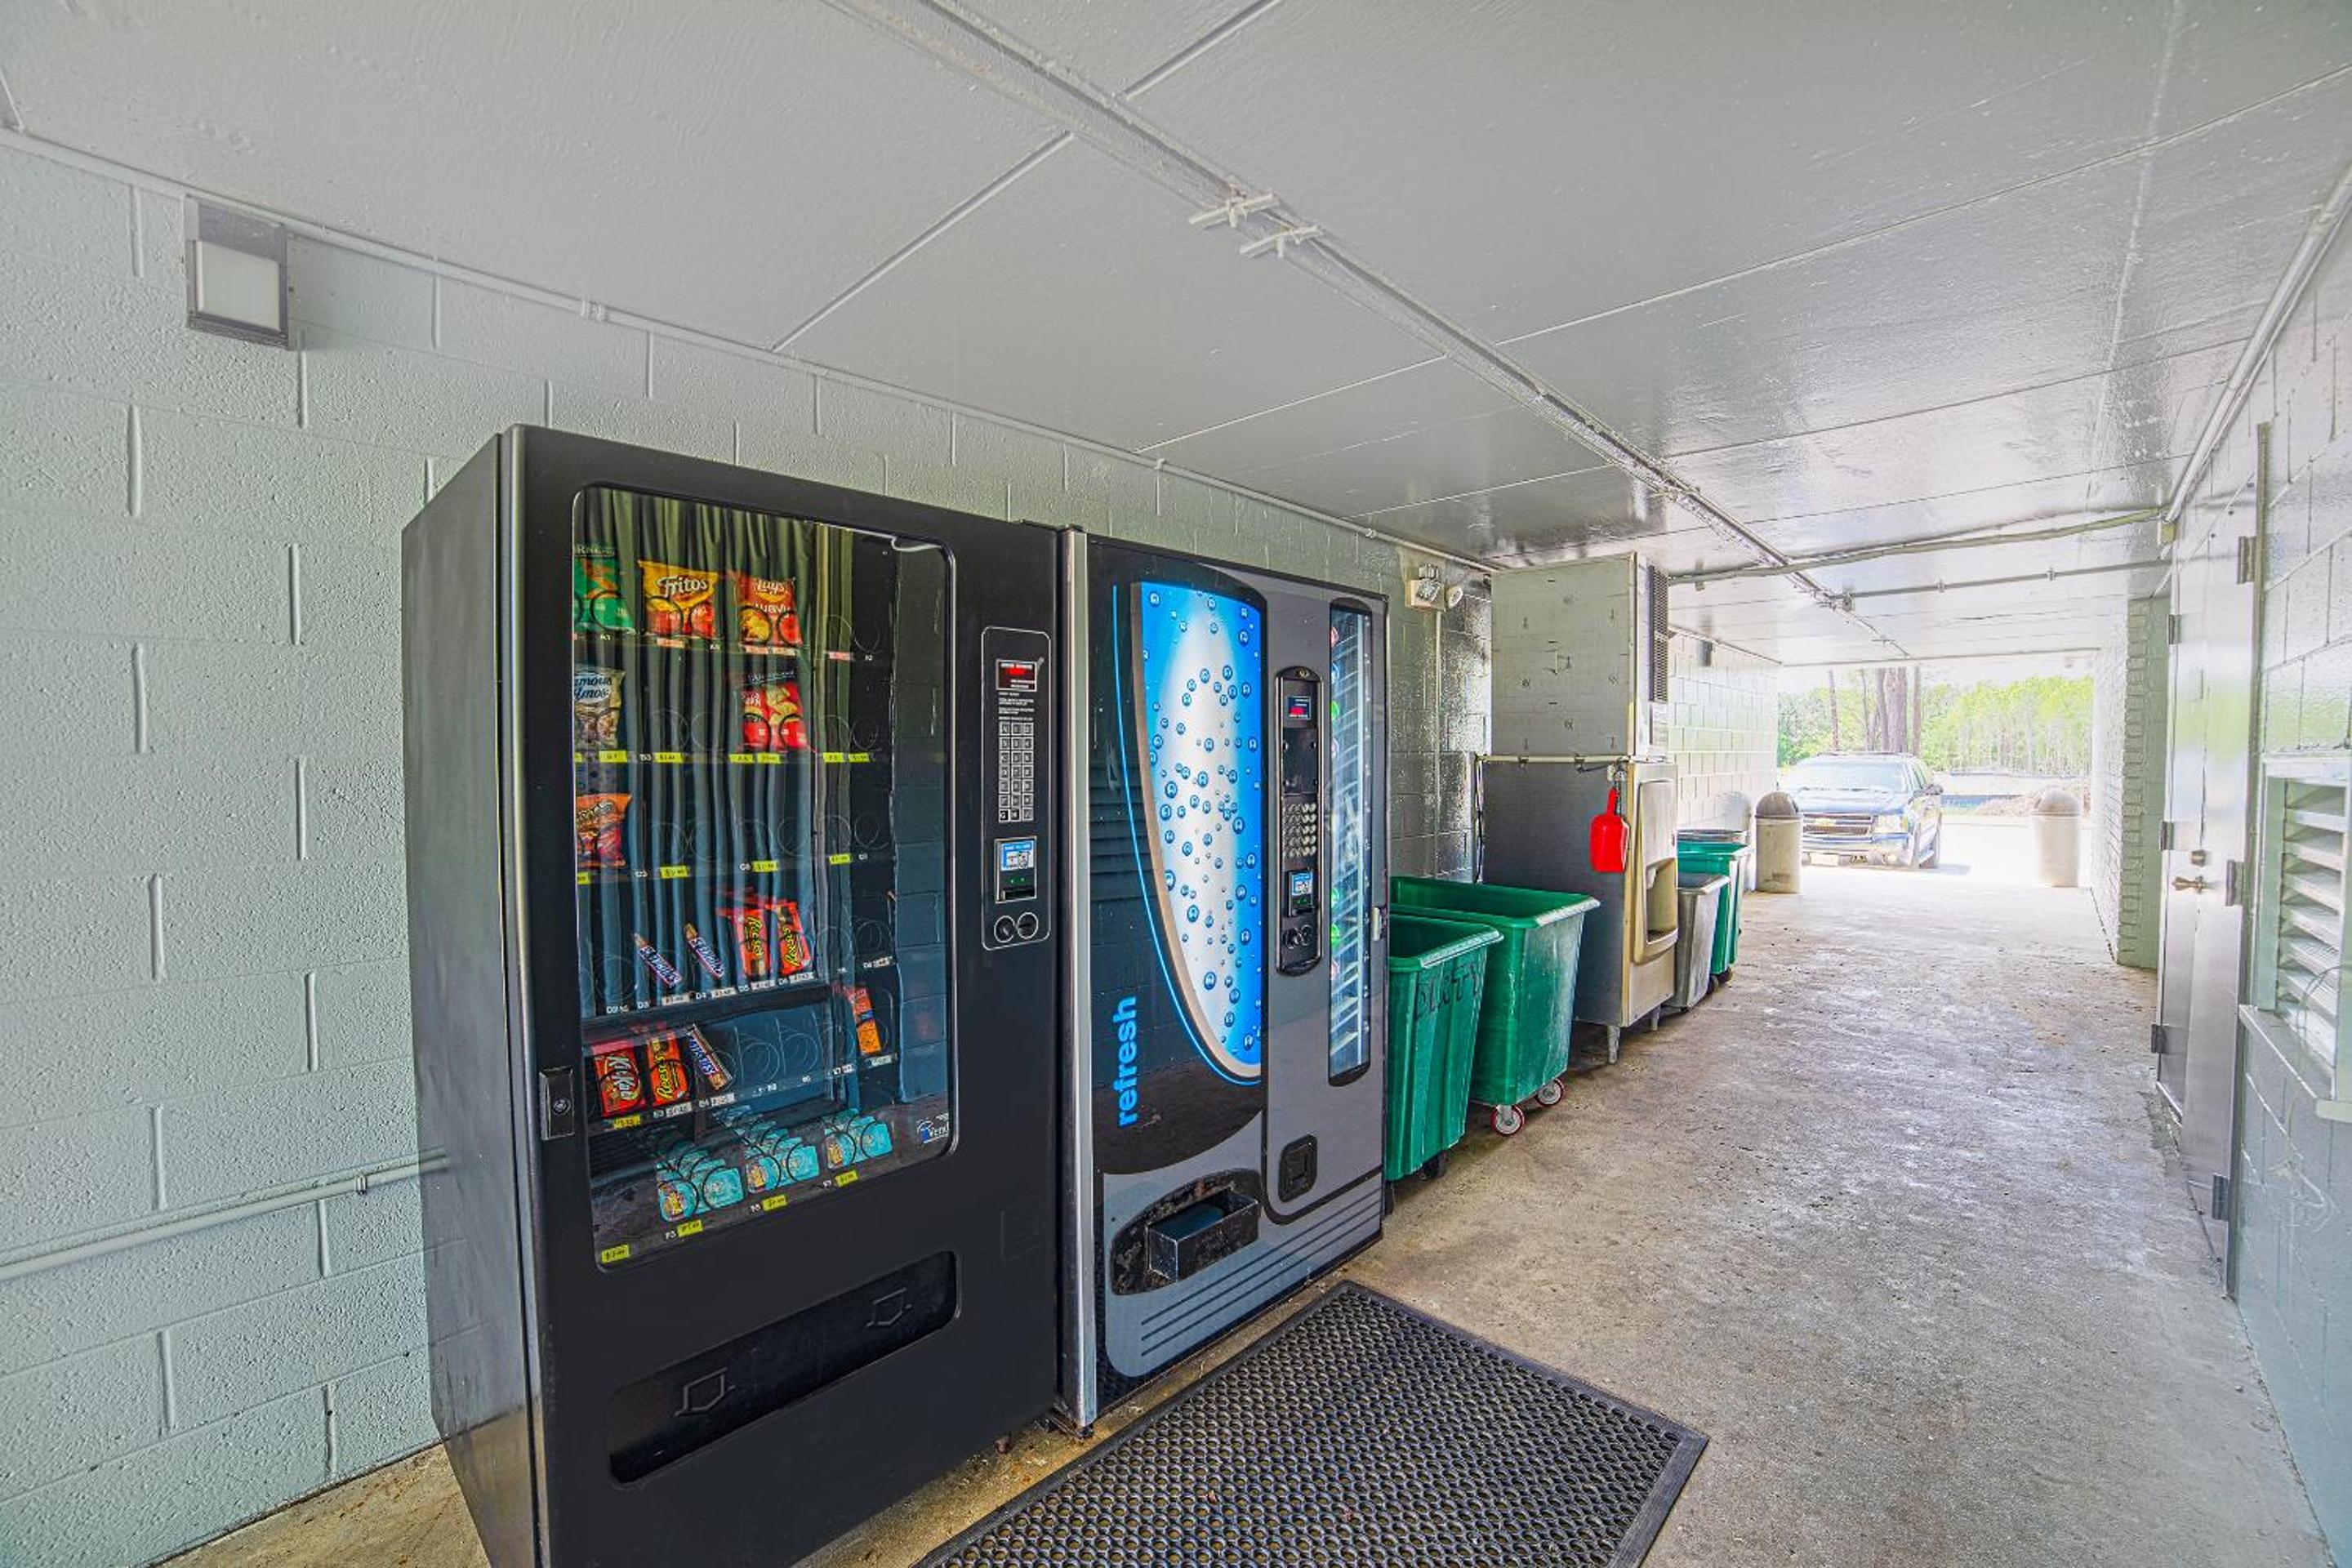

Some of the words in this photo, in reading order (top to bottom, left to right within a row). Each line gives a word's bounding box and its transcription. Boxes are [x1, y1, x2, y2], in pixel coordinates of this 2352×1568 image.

[657, 576, 708, 598] Fritos
[655, 1054, 673, 1099] Reese's
[1112, 996, 1138, 1127] refresh
